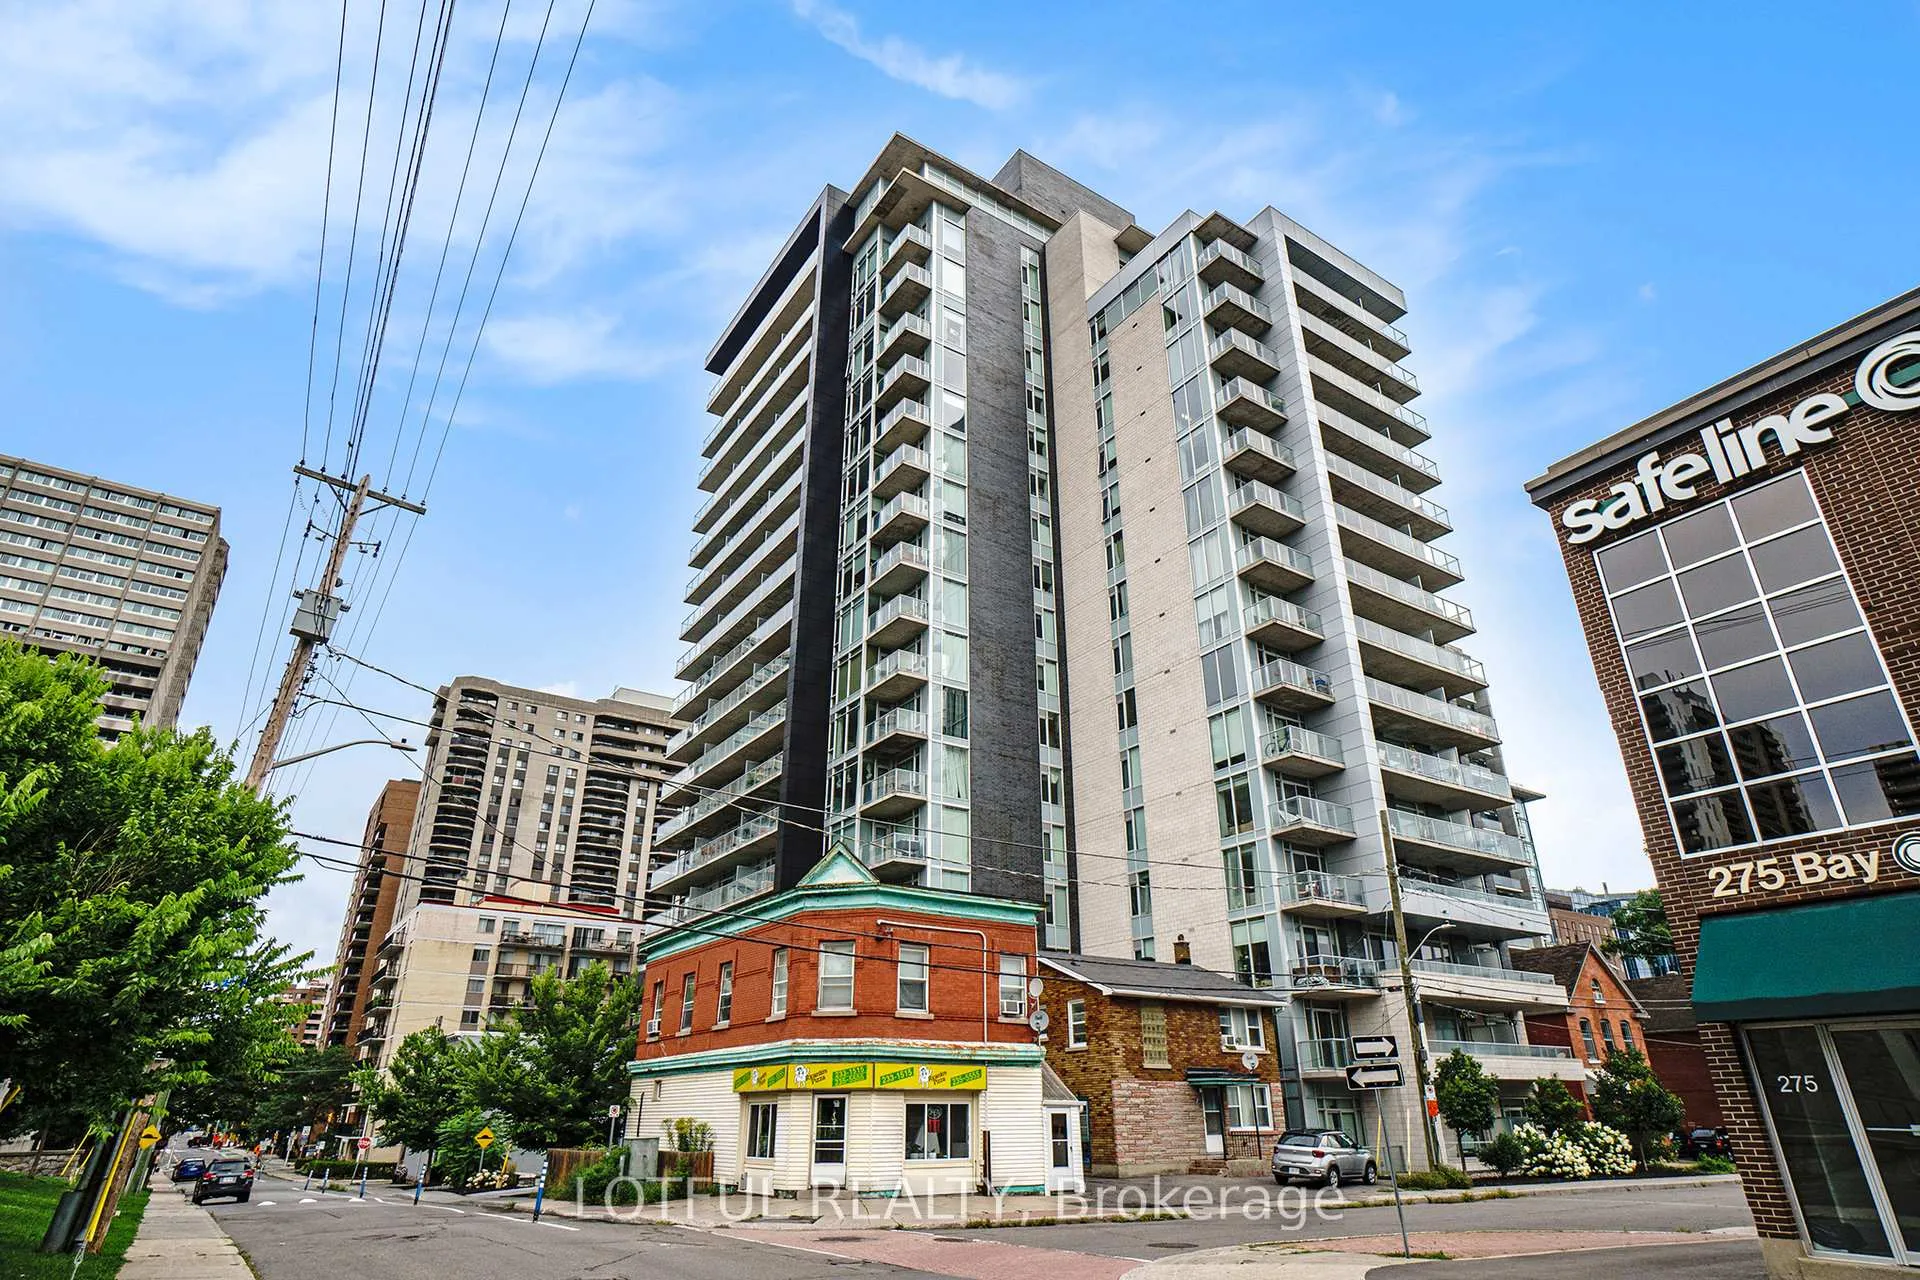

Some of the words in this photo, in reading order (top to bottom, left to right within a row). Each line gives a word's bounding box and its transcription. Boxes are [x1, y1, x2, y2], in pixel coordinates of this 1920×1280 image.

[1562, 393, 1849, 544] safeline
[1708, 858, 1786, 898] 275
[1792, 850, 1880, 885] Bay
[1777, 1075, 1818, 1092] 275
